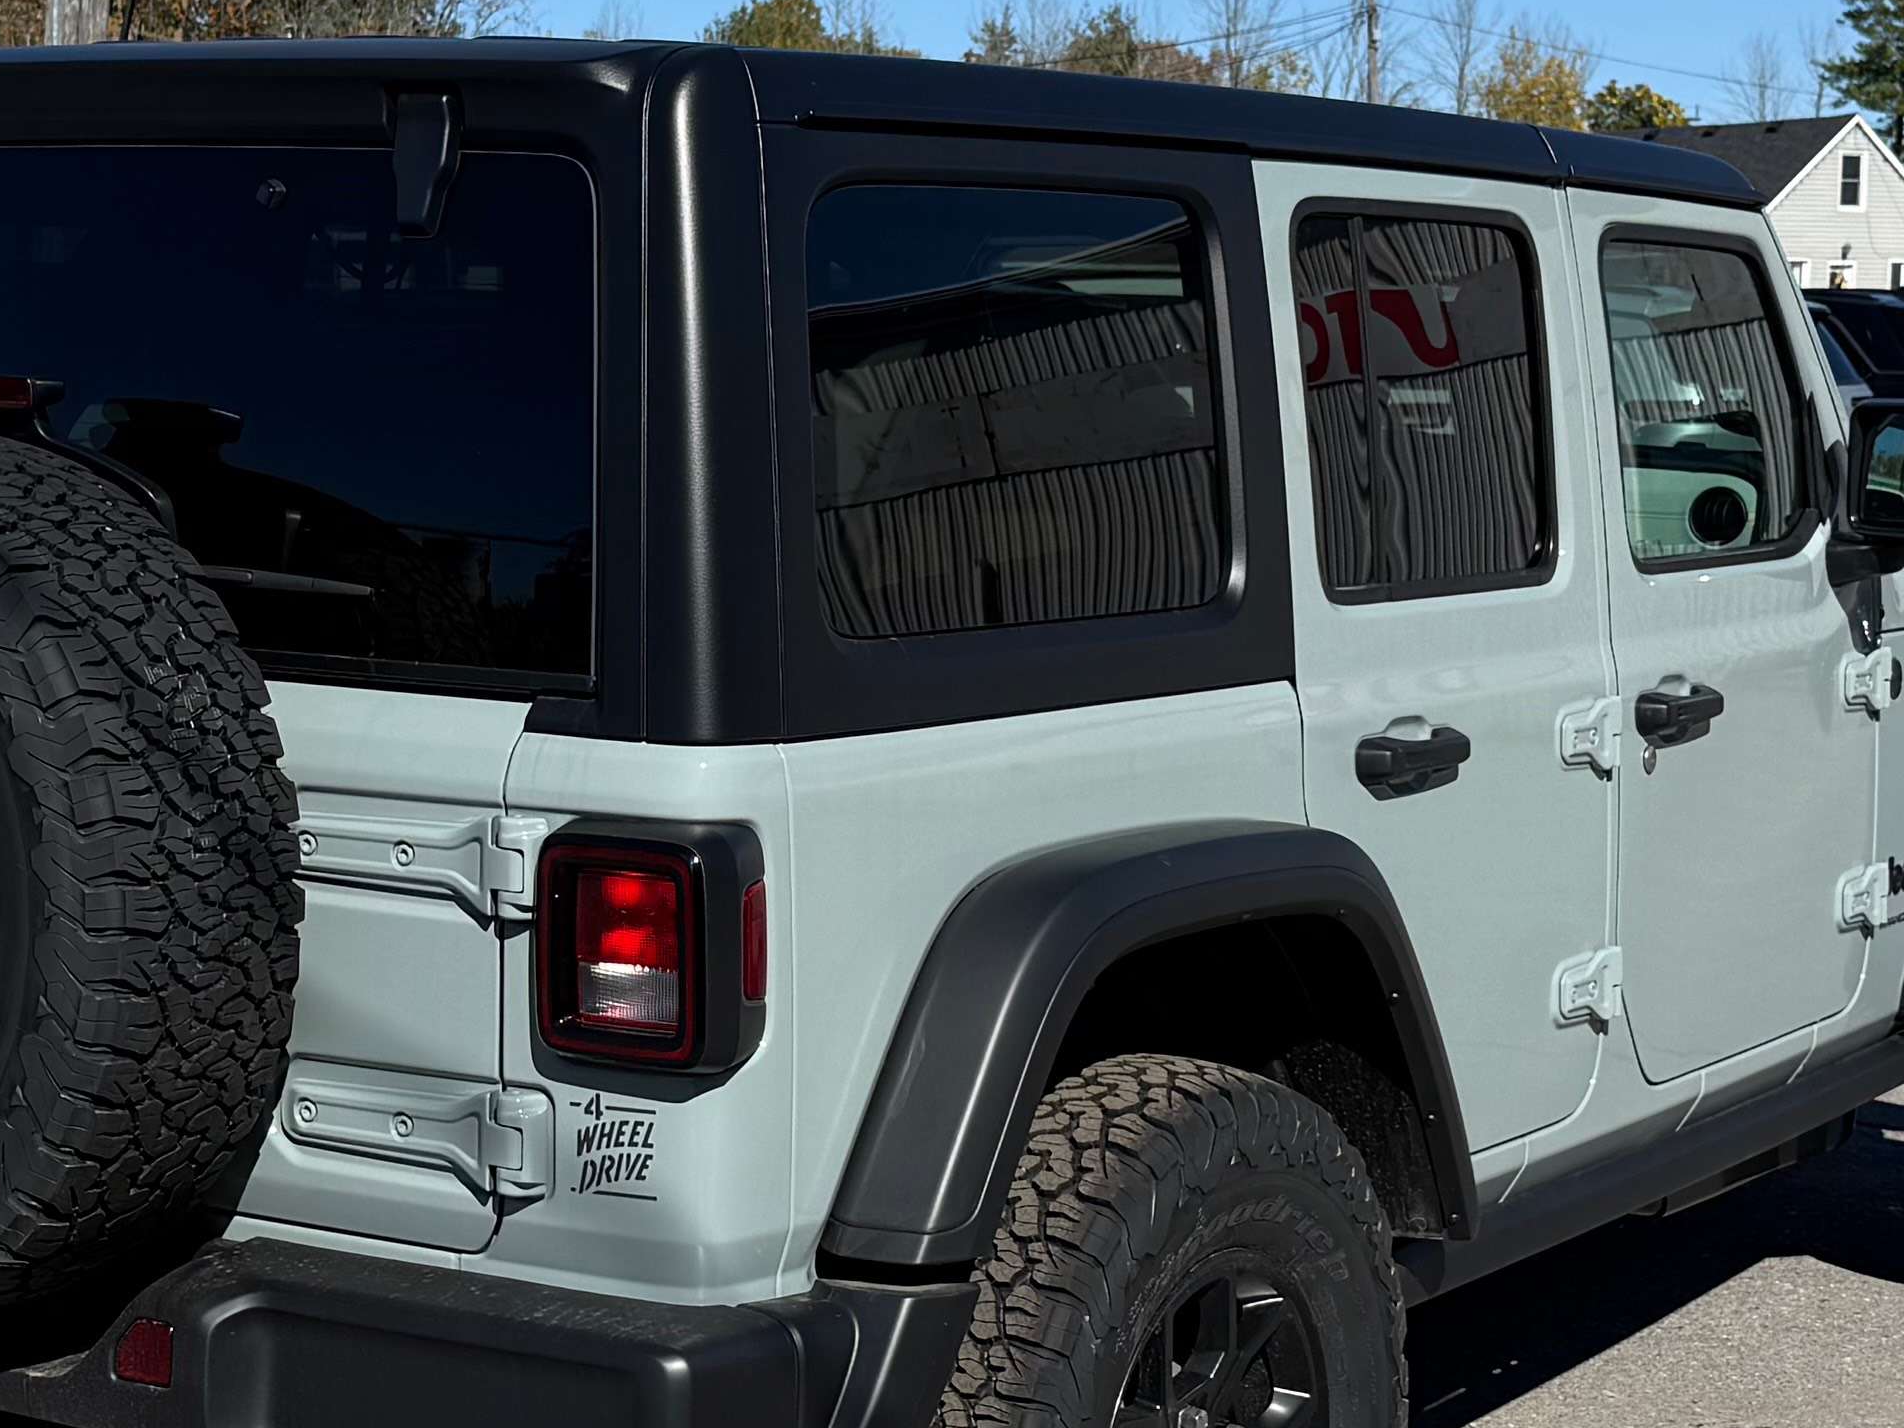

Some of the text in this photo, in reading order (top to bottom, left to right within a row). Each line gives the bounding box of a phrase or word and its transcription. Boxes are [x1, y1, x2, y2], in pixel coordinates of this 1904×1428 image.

[583, 1093, 603, 1120] 4
[576, 1119, 656, 1156] WHEEL
[579, 1153, 655, 1194] DRIVE
